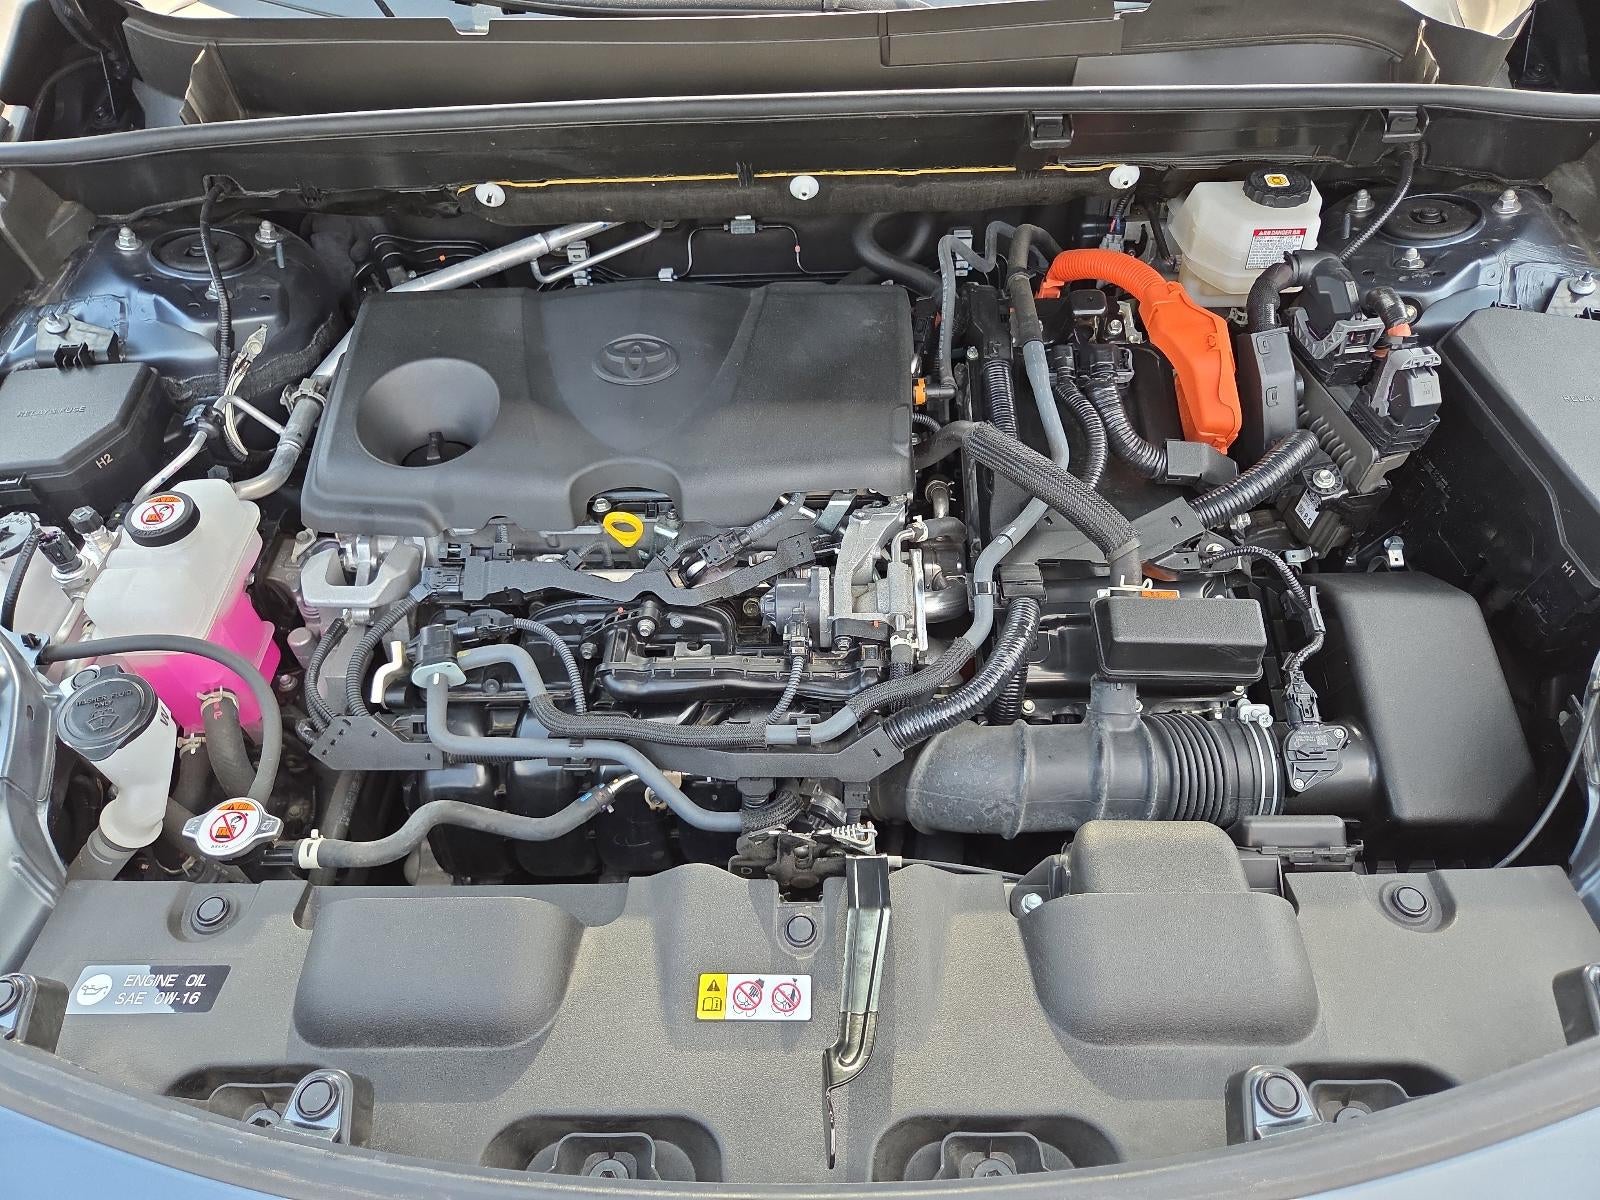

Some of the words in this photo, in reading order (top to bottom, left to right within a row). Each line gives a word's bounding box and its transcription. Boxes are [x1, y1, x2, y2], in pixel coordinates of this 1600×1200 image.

[95, 453, 114, 470] H2
[1561, 560, 1577, 578] H1
[76, 694, 108, 707] WASHER
[111, 689, 133, 700] FLUID
[124, 974, 178, 987] ENGINE
[185, 974, 207, 986] OIL
[114, 991, 147, 1005] SAE
[154, 991, 201, 1005] 0W-16
